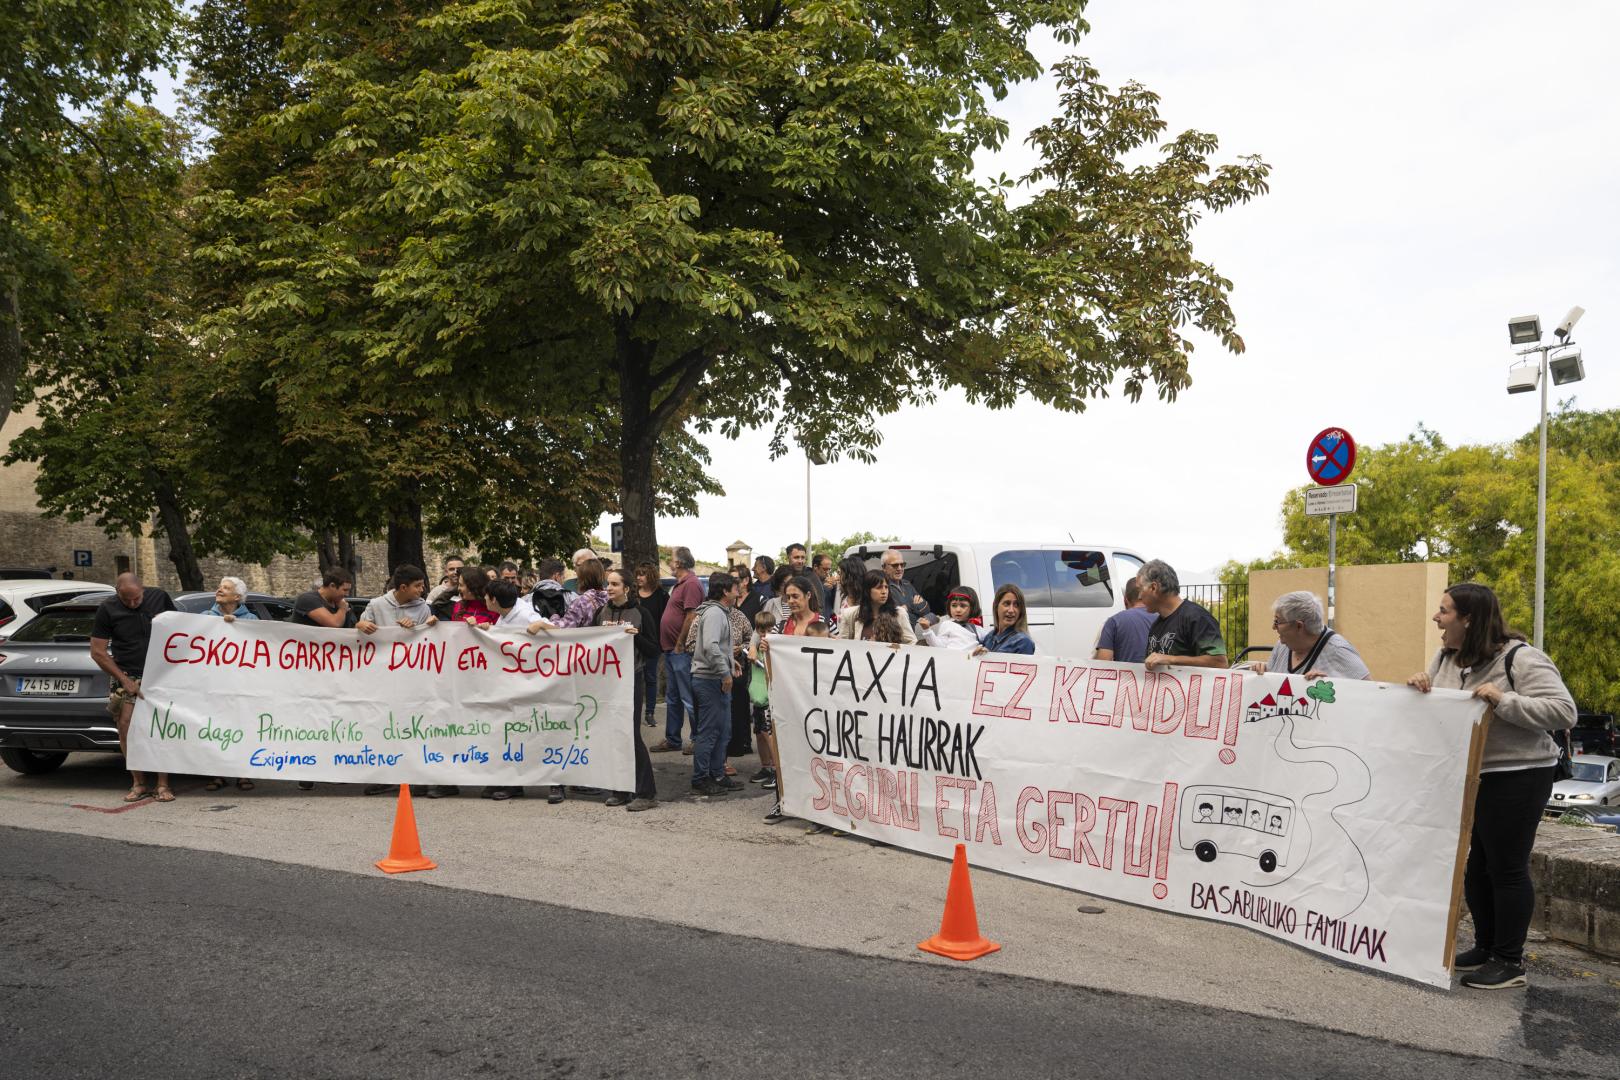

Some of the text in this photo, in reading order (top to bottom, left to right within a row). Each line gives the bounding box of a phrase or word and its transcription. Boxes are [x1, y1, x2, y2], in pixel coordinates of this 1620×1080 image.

[77, 551, 89, 565] P
[614, 525, 624, 549] P
[163, 632, 271, 668] ESKOLA
[458, 646, 488, 671] ETA
[500, 641, 622, 678] SEGURUA
[24, 679, 75, 691] 7415 MGB
[800, 647, 1243, 765] TAXIA EZ KENDU!
[150, 701, 187, 740] Non
[198, 717, 244, 750] dago
[804, 708, 985, 781] GURE HAURRAK
[249, 743, 589, 771] Exigimos mantener las rutas del 25/26
[810, 757, 1179, 900] SEGURU ETA GERTU!
[1190, 882, 1387, 963] BASABURUKO FAMILIAK
